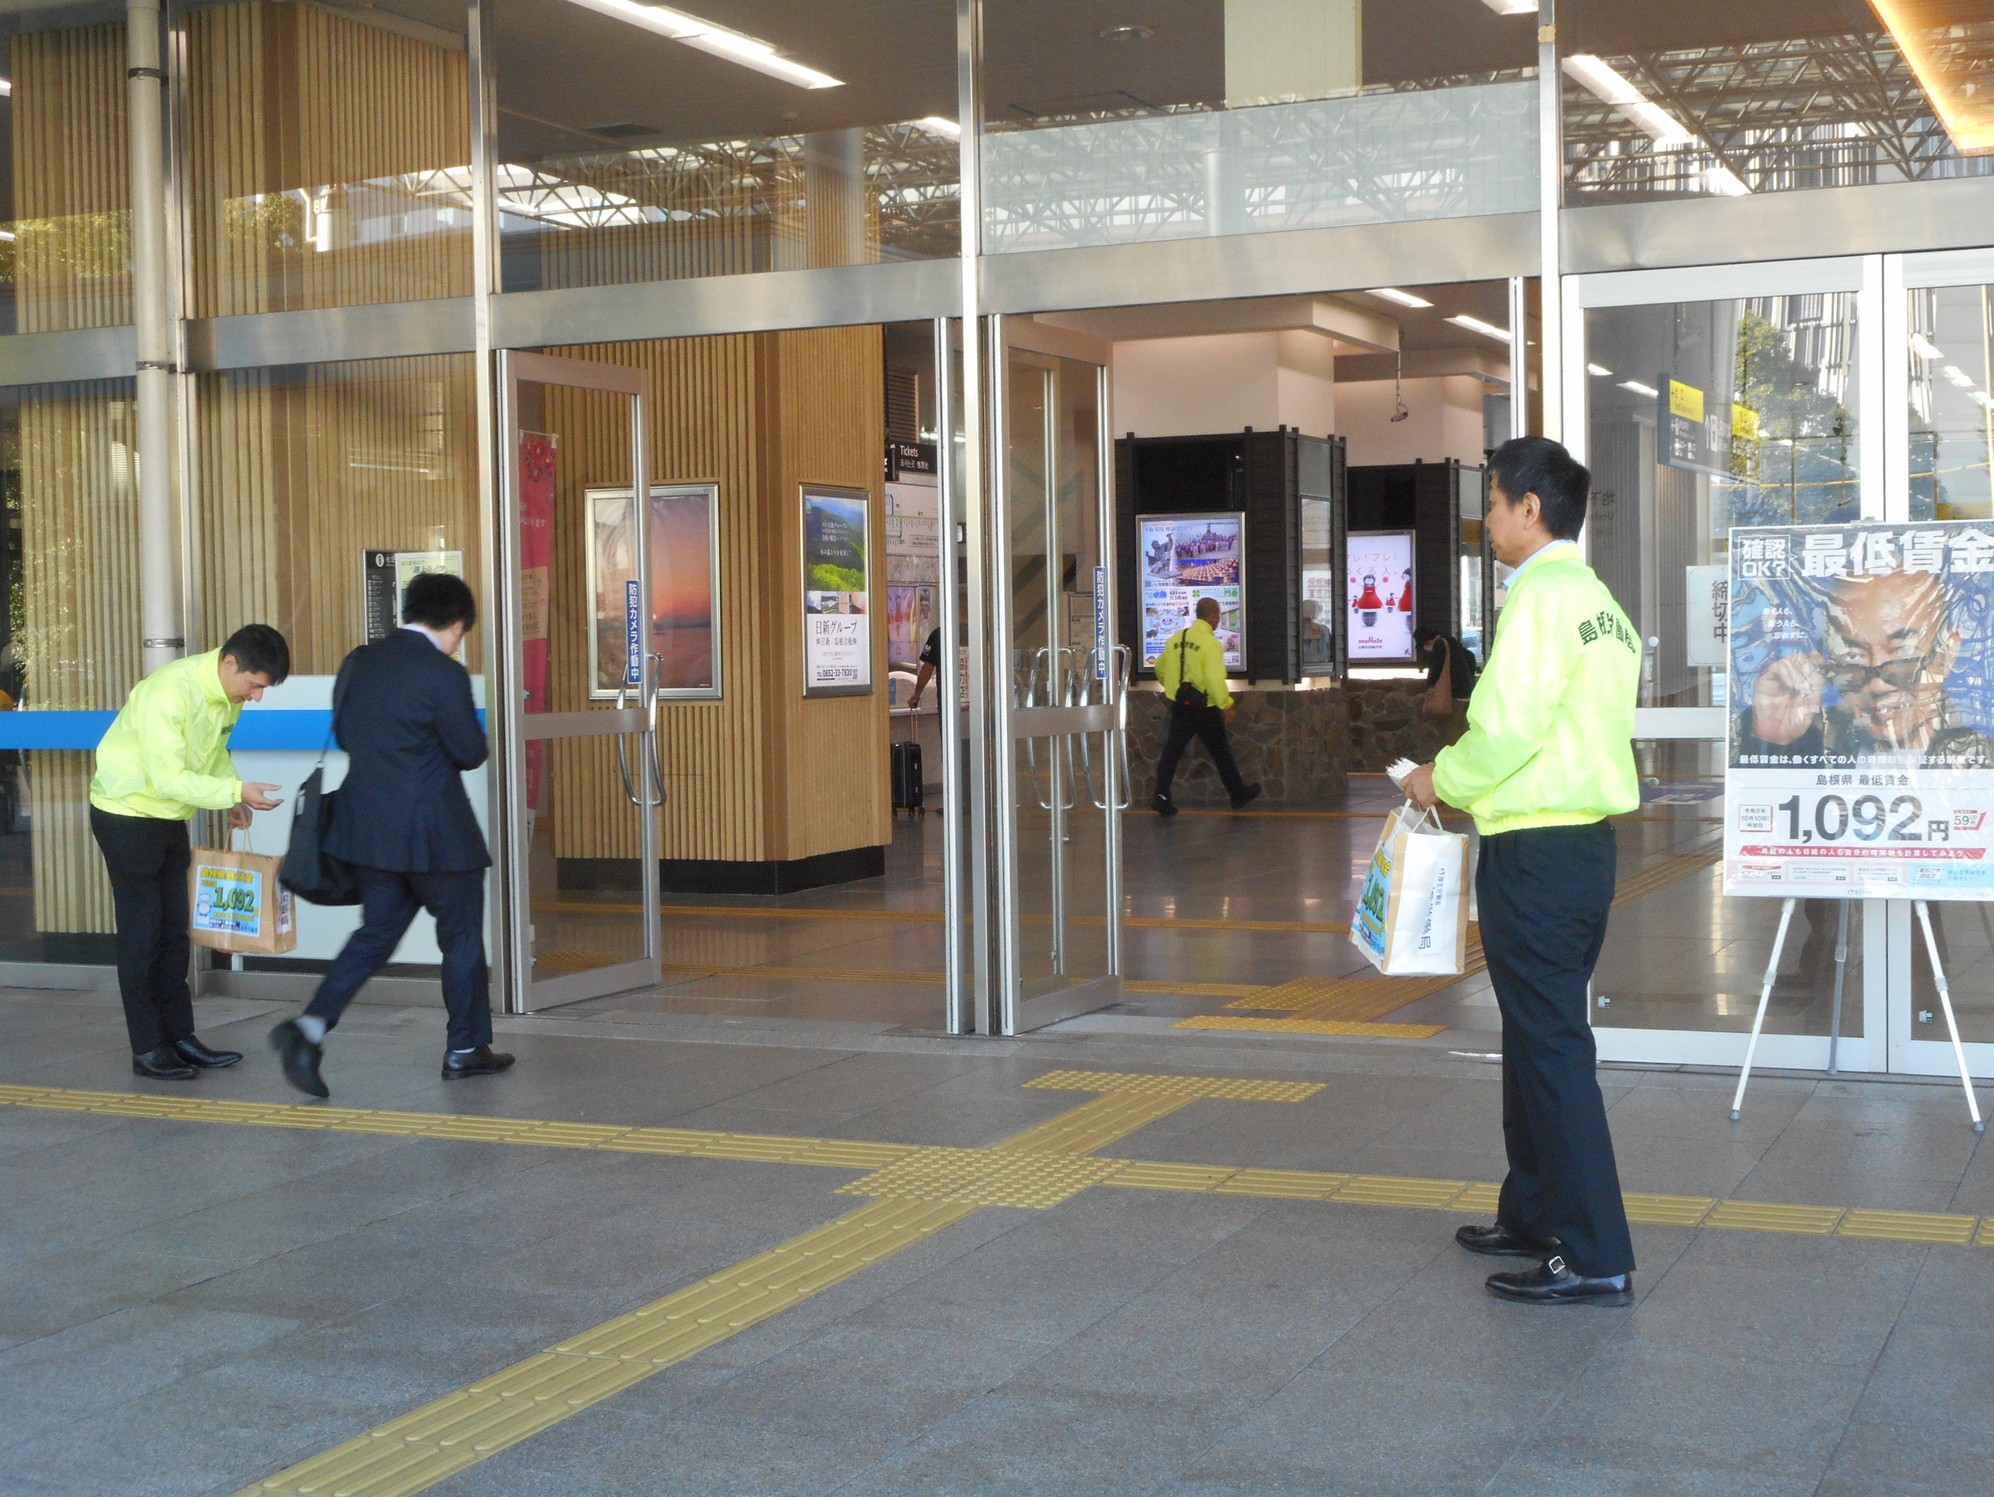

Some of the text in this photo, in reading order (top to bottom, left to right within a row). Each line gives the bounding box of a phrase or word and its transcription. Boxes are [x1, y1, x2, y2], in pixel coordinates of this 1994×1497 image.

[900, 445, 919, 457] Tickets
[1742, 539, 1786, 560] 確認
[1802, 528, 1994, 578] 最低賃金
[1742, 562, 1786, 577] OK?
[1711, 580, 1729, 644] 締切中
[628, 583, 640, 680] 防犯カメラ作動中
[815, 620, 858, 635] 日新グループ
[1815, 774, 1909, 786] 島根県 最低賃金
[1778, 794, 1950, 844] 1,092円
